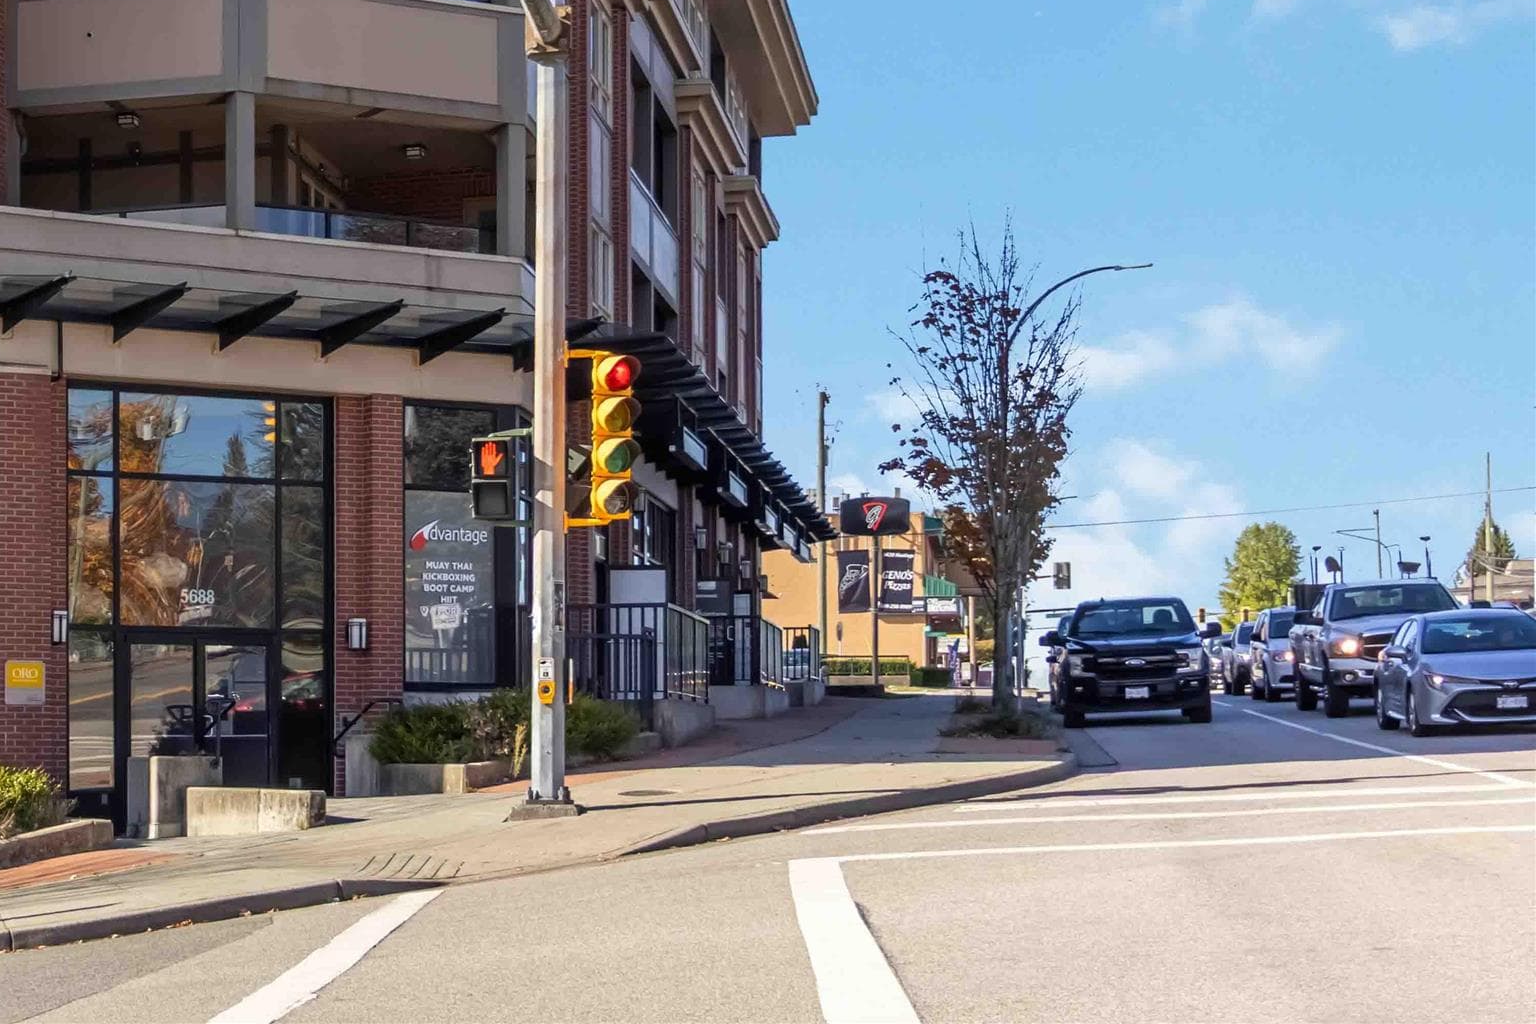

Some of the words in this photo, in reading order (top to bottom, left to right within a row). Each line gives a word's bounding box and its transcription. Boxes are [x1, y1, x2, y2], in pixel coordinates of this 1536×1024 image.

[425, 561, 449, 570] MUAY
[452, 562, 473, 570] THAI
[422, 573, 476, 582] KICKBOXING
[423, 584, 448, 592] BOOT
[449, 584, 474, 593] CAMP
[180, 588, 215, 604] 5688
[440, 596, 457, 604] HIIT
